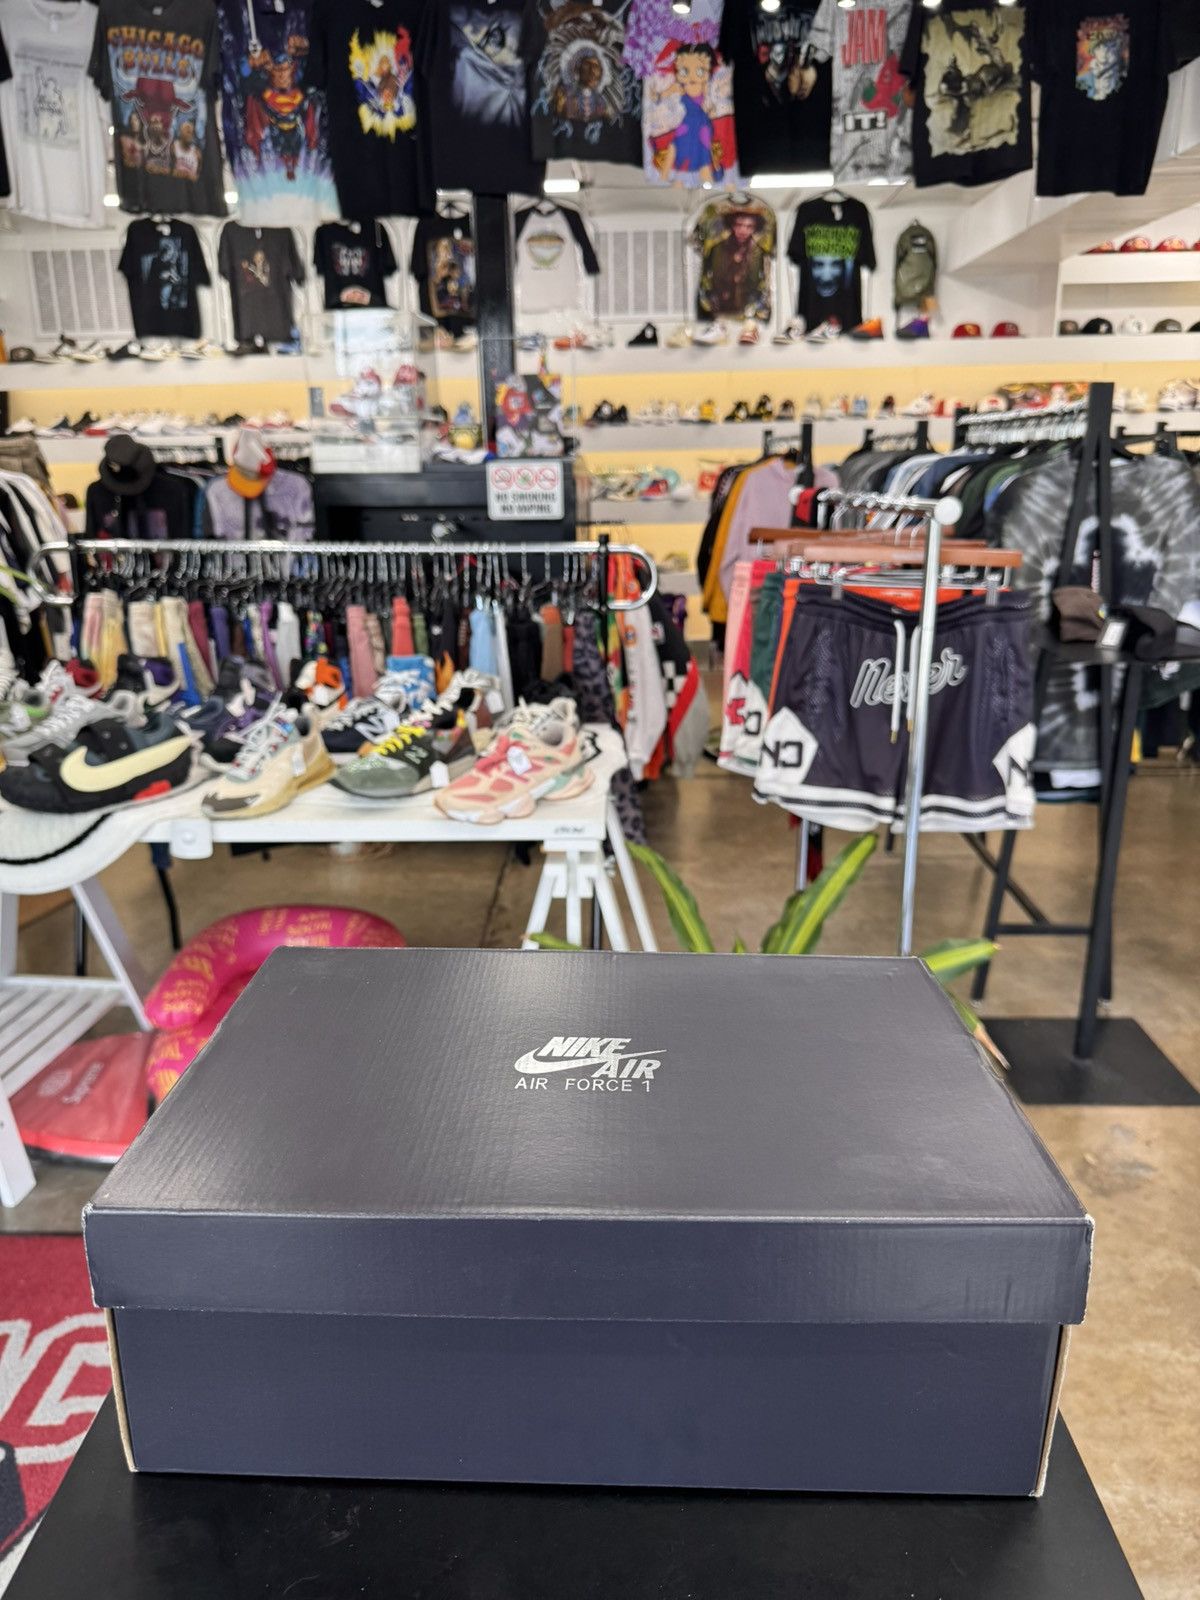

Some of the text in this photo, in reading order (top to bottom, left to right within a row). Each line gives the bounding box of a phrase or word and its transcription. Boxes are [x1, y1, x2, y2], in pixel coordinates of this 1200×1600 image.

[106, 26, 205, 59] CHICAGO
[844, 111, 886, 131] IT!
[537, 1036, 632, 1058] NIKE
[591, 1056, 661, 1079] AIR
[514, 1077, 651, 1093] AIR FORCE 1
